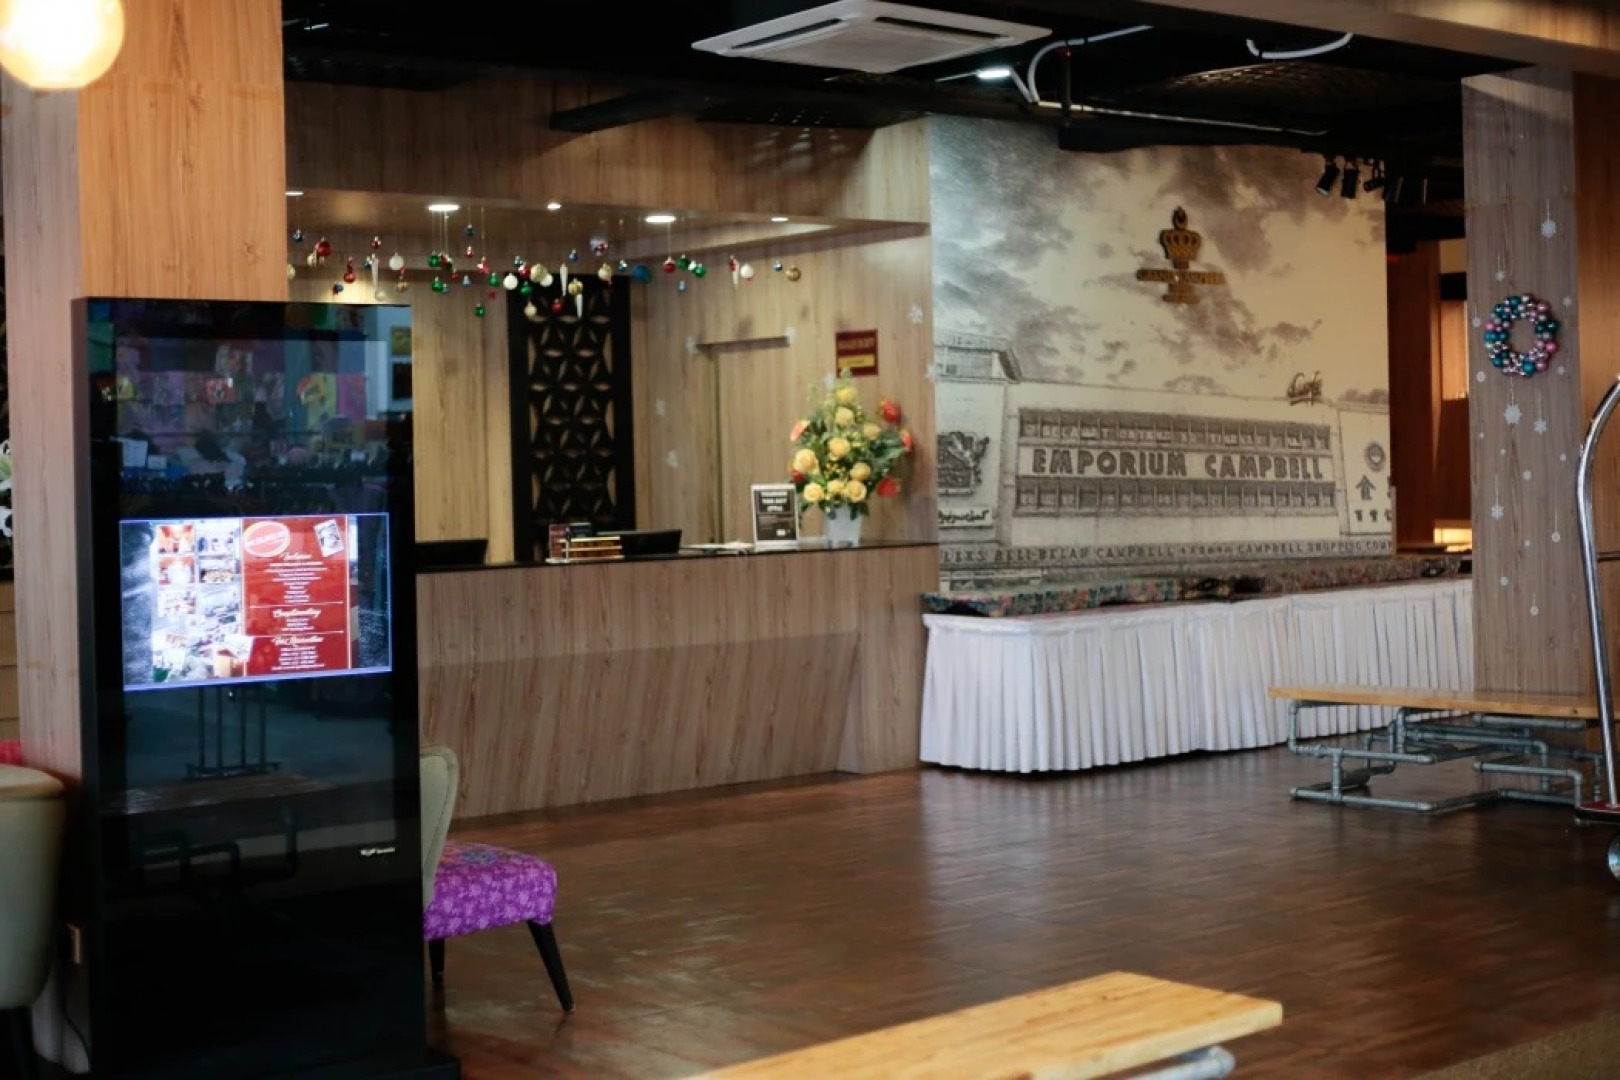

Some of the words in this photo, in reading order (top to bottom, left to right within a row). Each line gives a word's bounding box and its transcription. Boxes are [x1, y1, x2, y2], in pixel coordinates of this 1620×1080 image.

[1032, 448, 1187, 476] EMPORIUM
[1204, 454, 1323, 479] CAMPBELL
[1238, 541, 1303, 554] CAMPBELL
